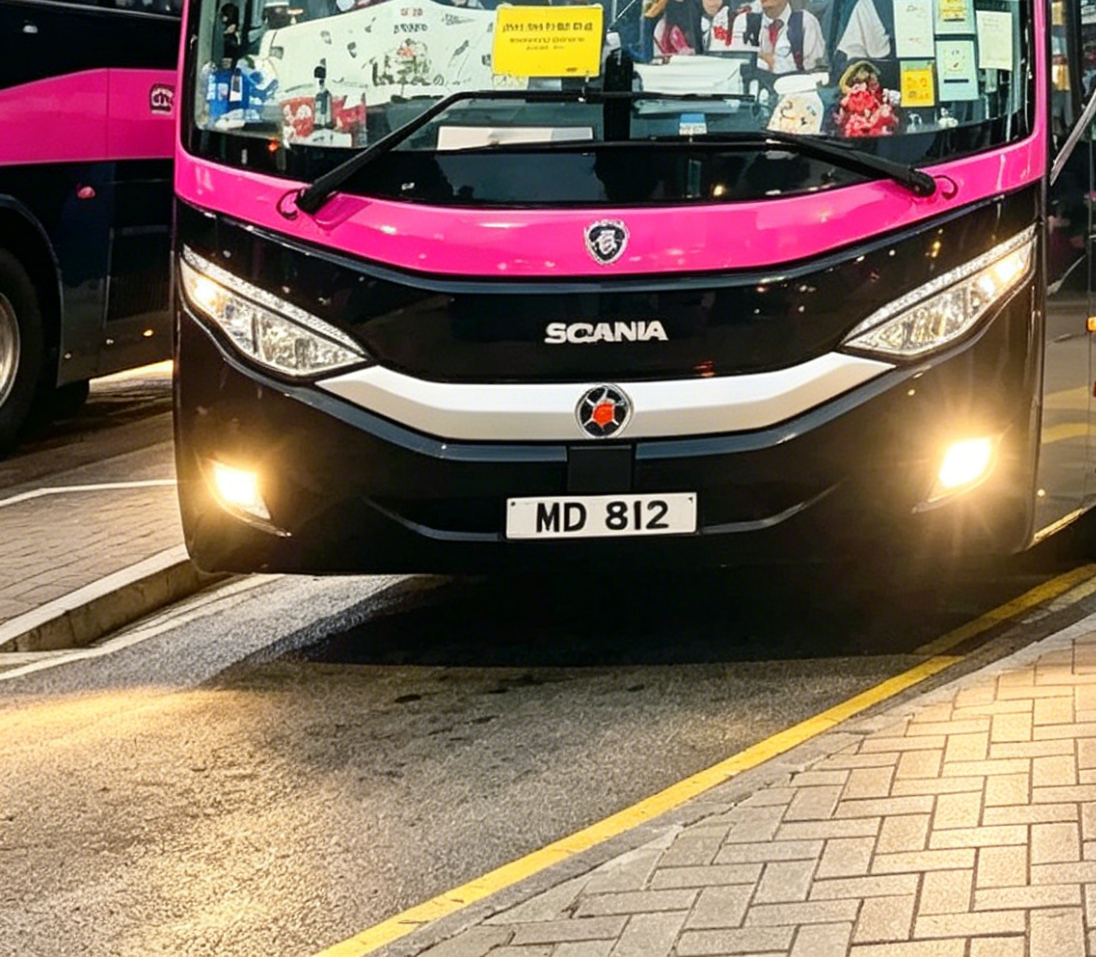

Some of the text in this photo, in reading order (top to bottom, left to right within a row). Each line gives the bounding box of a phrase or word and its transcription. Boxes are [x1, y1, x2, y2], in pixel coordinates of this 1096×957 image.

[544, 321, 668, 344] SCANIA
[536, 500, 669, 532] MD 812
